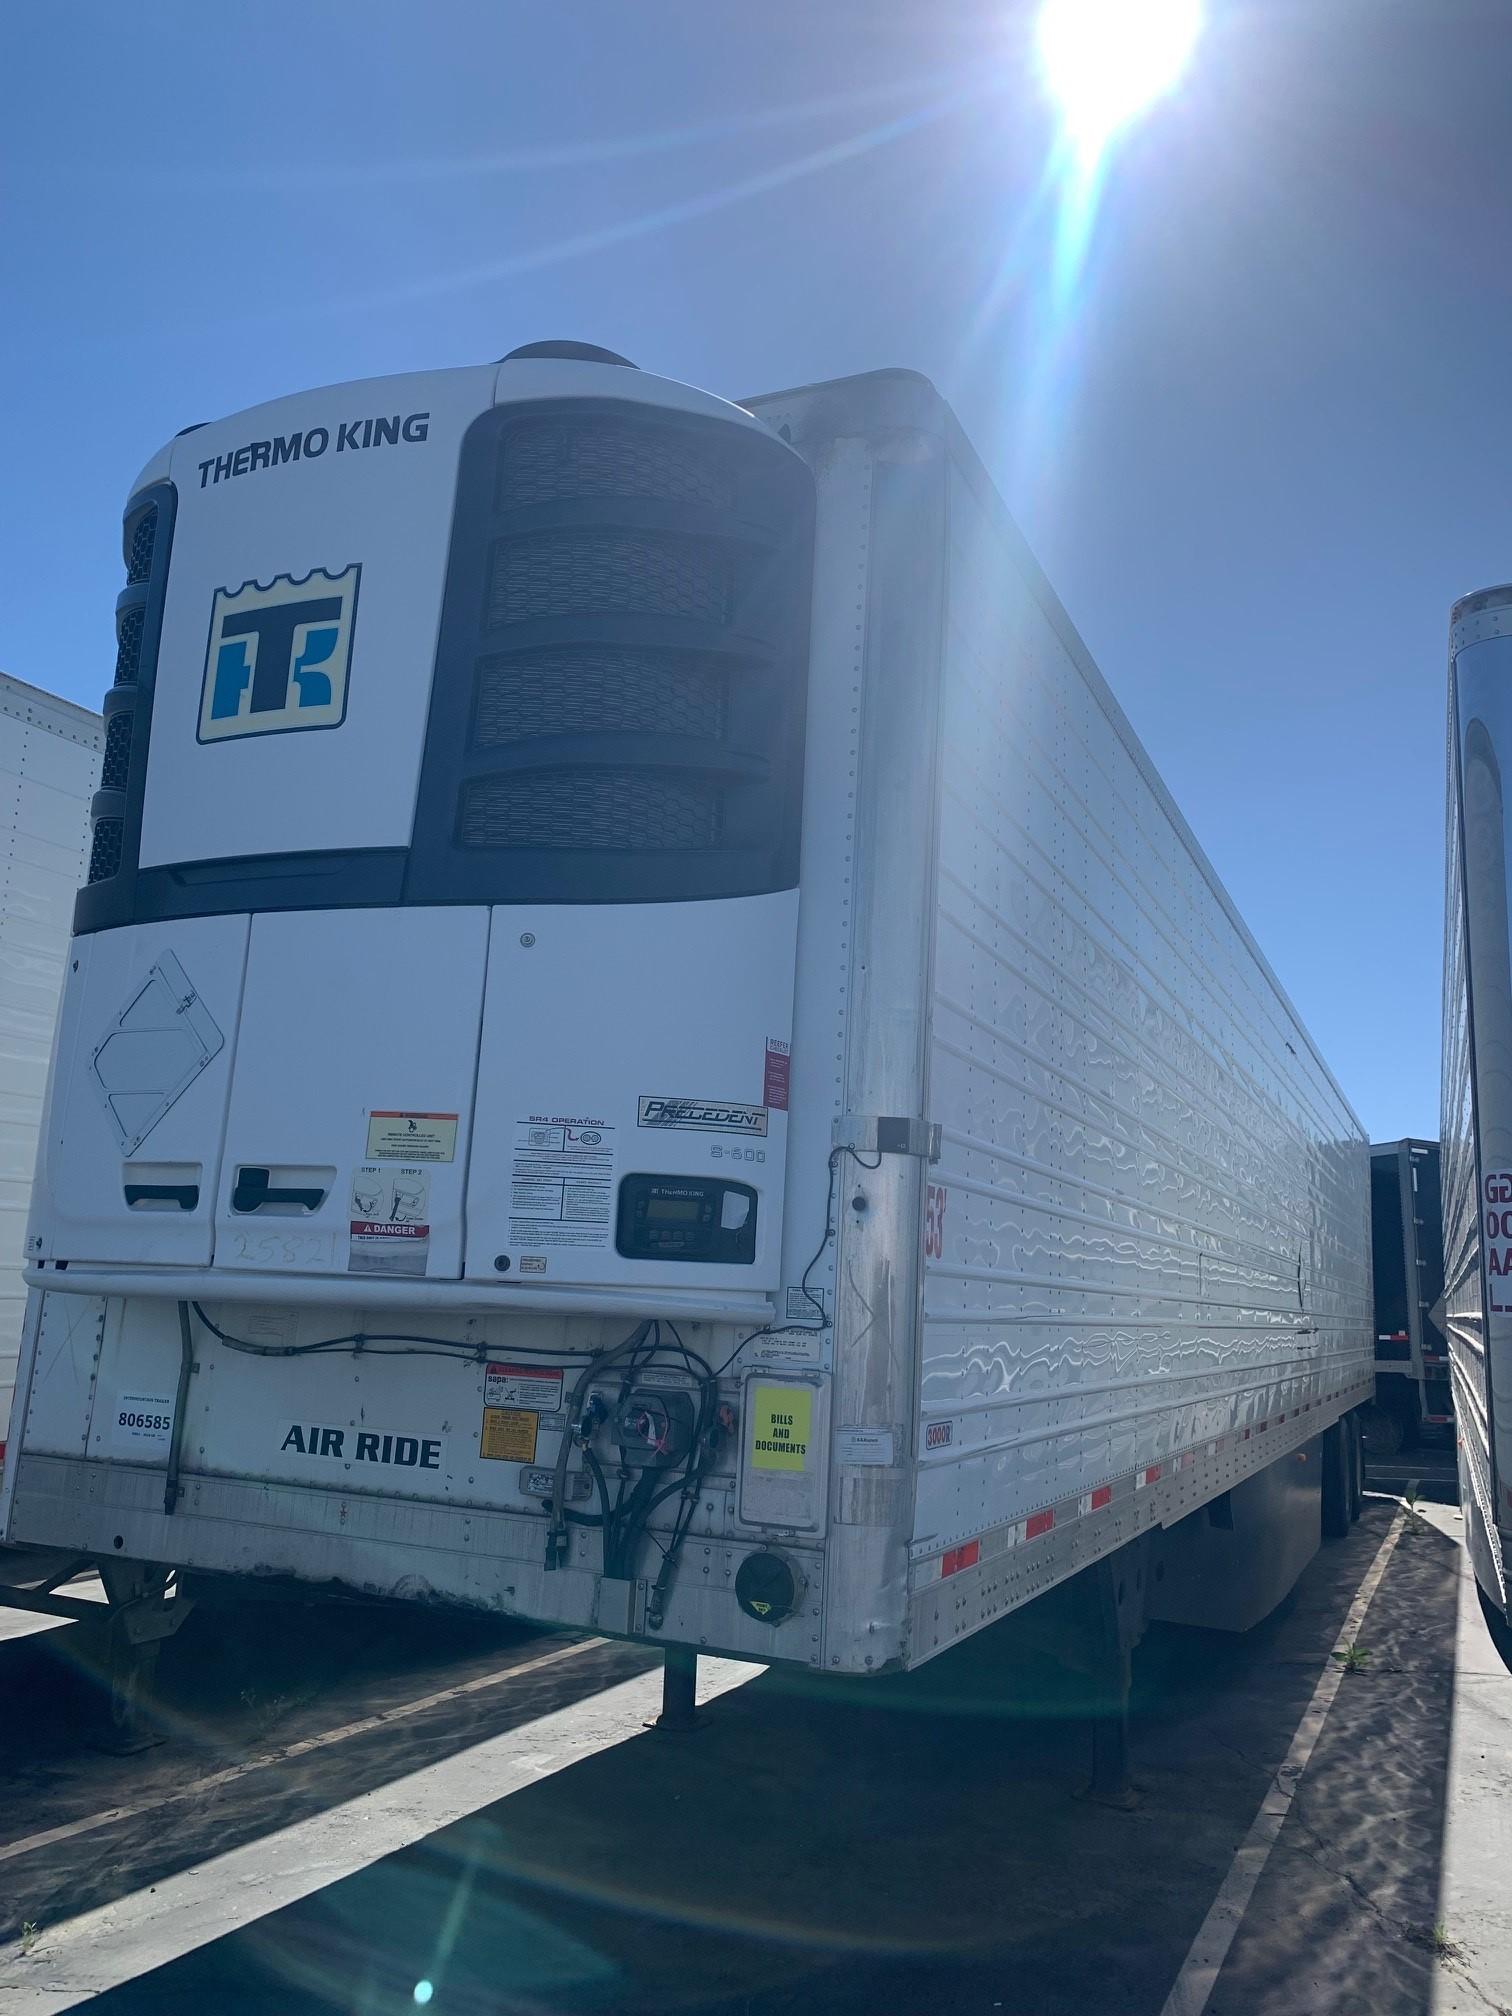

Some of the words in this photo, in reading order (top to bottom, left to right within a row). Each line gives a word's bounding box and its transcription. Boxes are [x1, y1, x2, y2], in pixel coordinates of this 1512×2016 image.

[198, 427, 329, 488] THERMO
[336, 412, 431, 453] KING
[528, 1115, 549, 1123] SR4
[551, 1116, 605, 1126] OPERATION
[644, 1100, 766, 1126] PRECEDENT
[710, 1144, 766, 1163] S-600
[361, 1166, 376, 1174] STEP
[400, 1168, 416, 1176] STEP
[416, 1168, 423, 1176] 2
[373, 1223, 416, 1236] DANGER
[118, 1412, 171, 1430] 806585
[770, 1413, 794, 1426] BILLS
[772, 1427, 790, 1440] AND
[926, 1422, 951, 1446] 3000R
[280, 1424, 345, 1458] AIR
[355, 1432, 442, 1470] RIDE
[755, 1439, 807, 1456] DOCUMENTS
